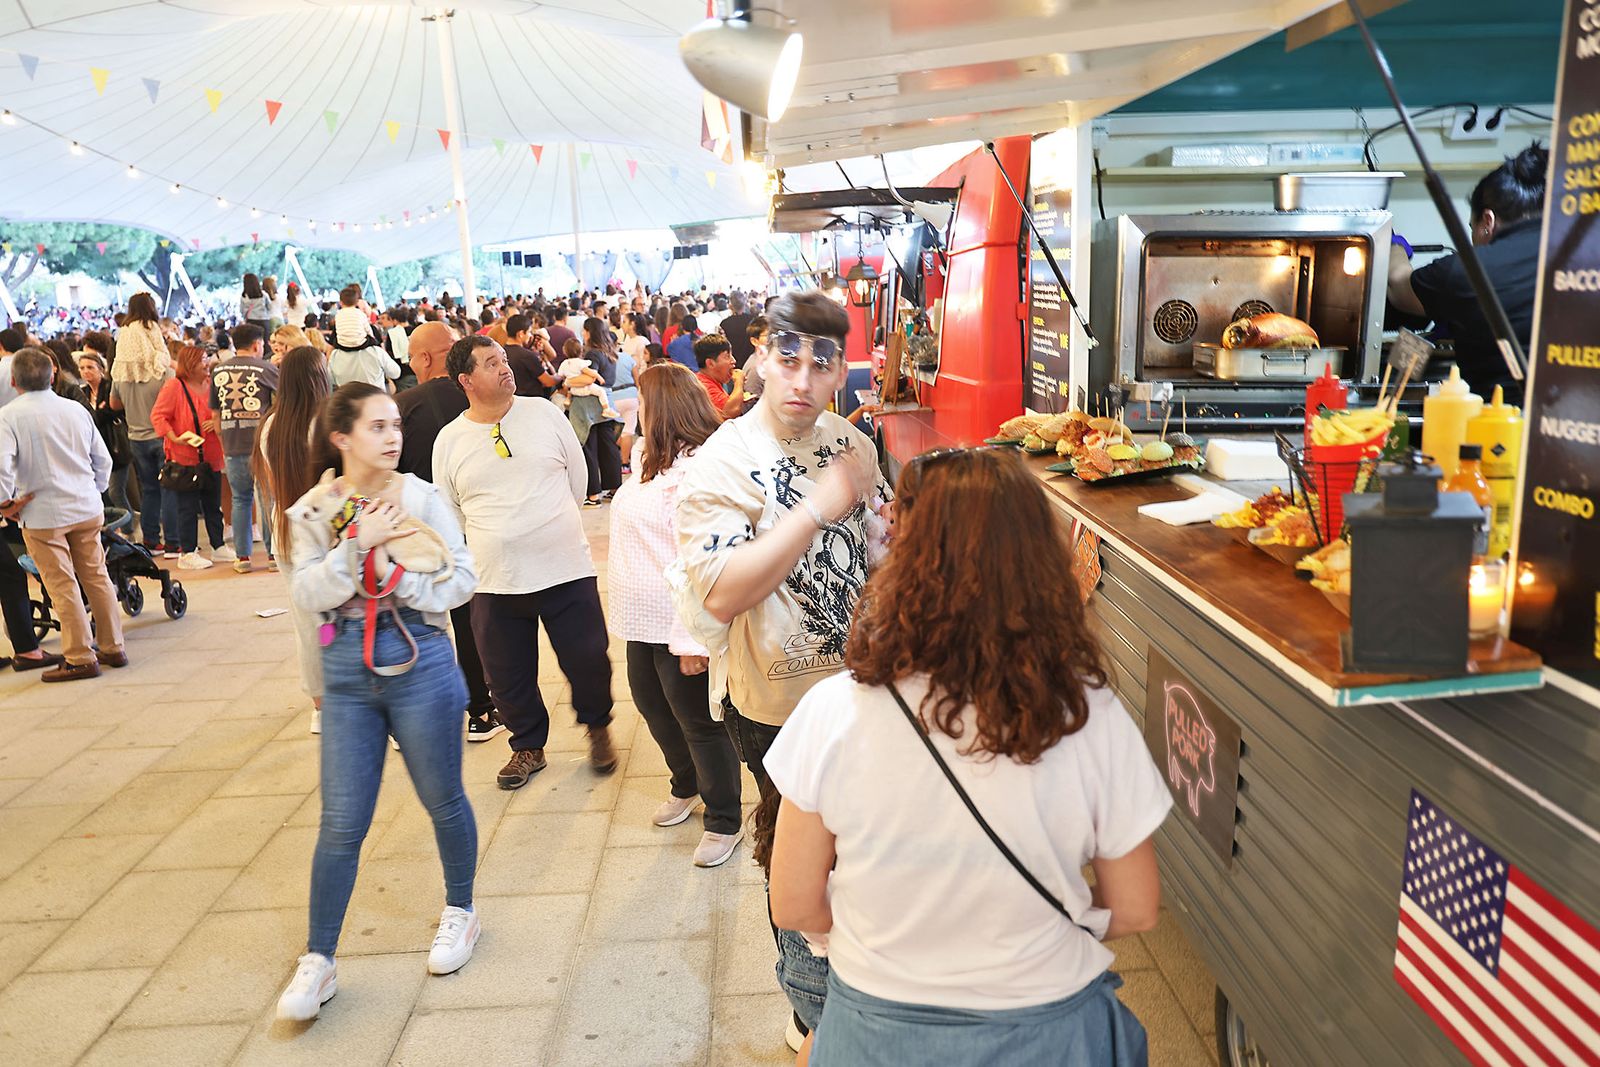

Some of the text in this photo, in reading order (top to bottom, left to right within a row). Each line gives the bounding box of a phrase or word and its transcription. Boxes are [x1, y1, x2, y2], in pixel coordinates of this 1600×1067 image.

[1533, 486, 1595, 519] COMBO
[1168, 699, 1207, 753] PULLED
[1172, 727, 1200, 771] PORK
